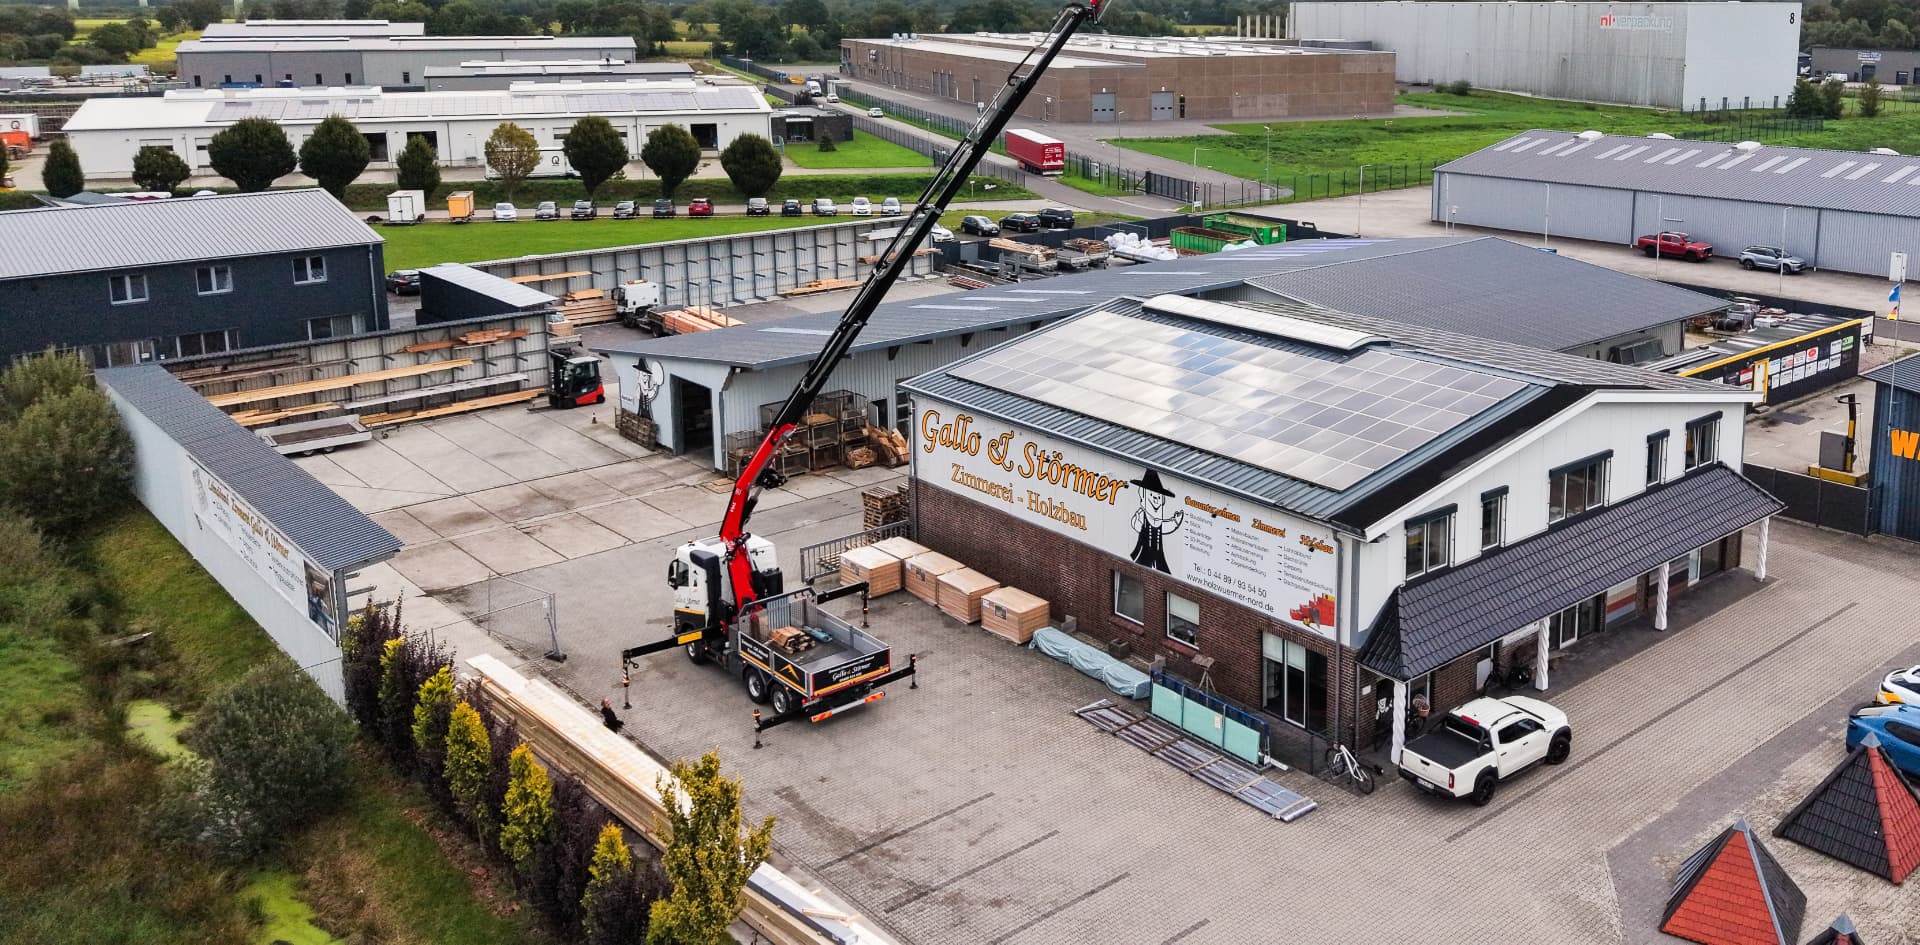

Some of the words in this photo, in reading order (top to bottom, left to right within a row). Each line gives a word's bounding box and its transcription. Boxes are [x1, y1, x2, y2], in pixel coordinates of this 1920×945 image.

[1789, 12, 1795, 24] 8
[922, 410, 981, 456] Gallo
[1018, 441, 1124, 505] Störmer
[1891, 429, 1920, 461] W
[951, 463, 1013, 503] Zimmerei
[1027, 490, 1087, 531] Holzbau
